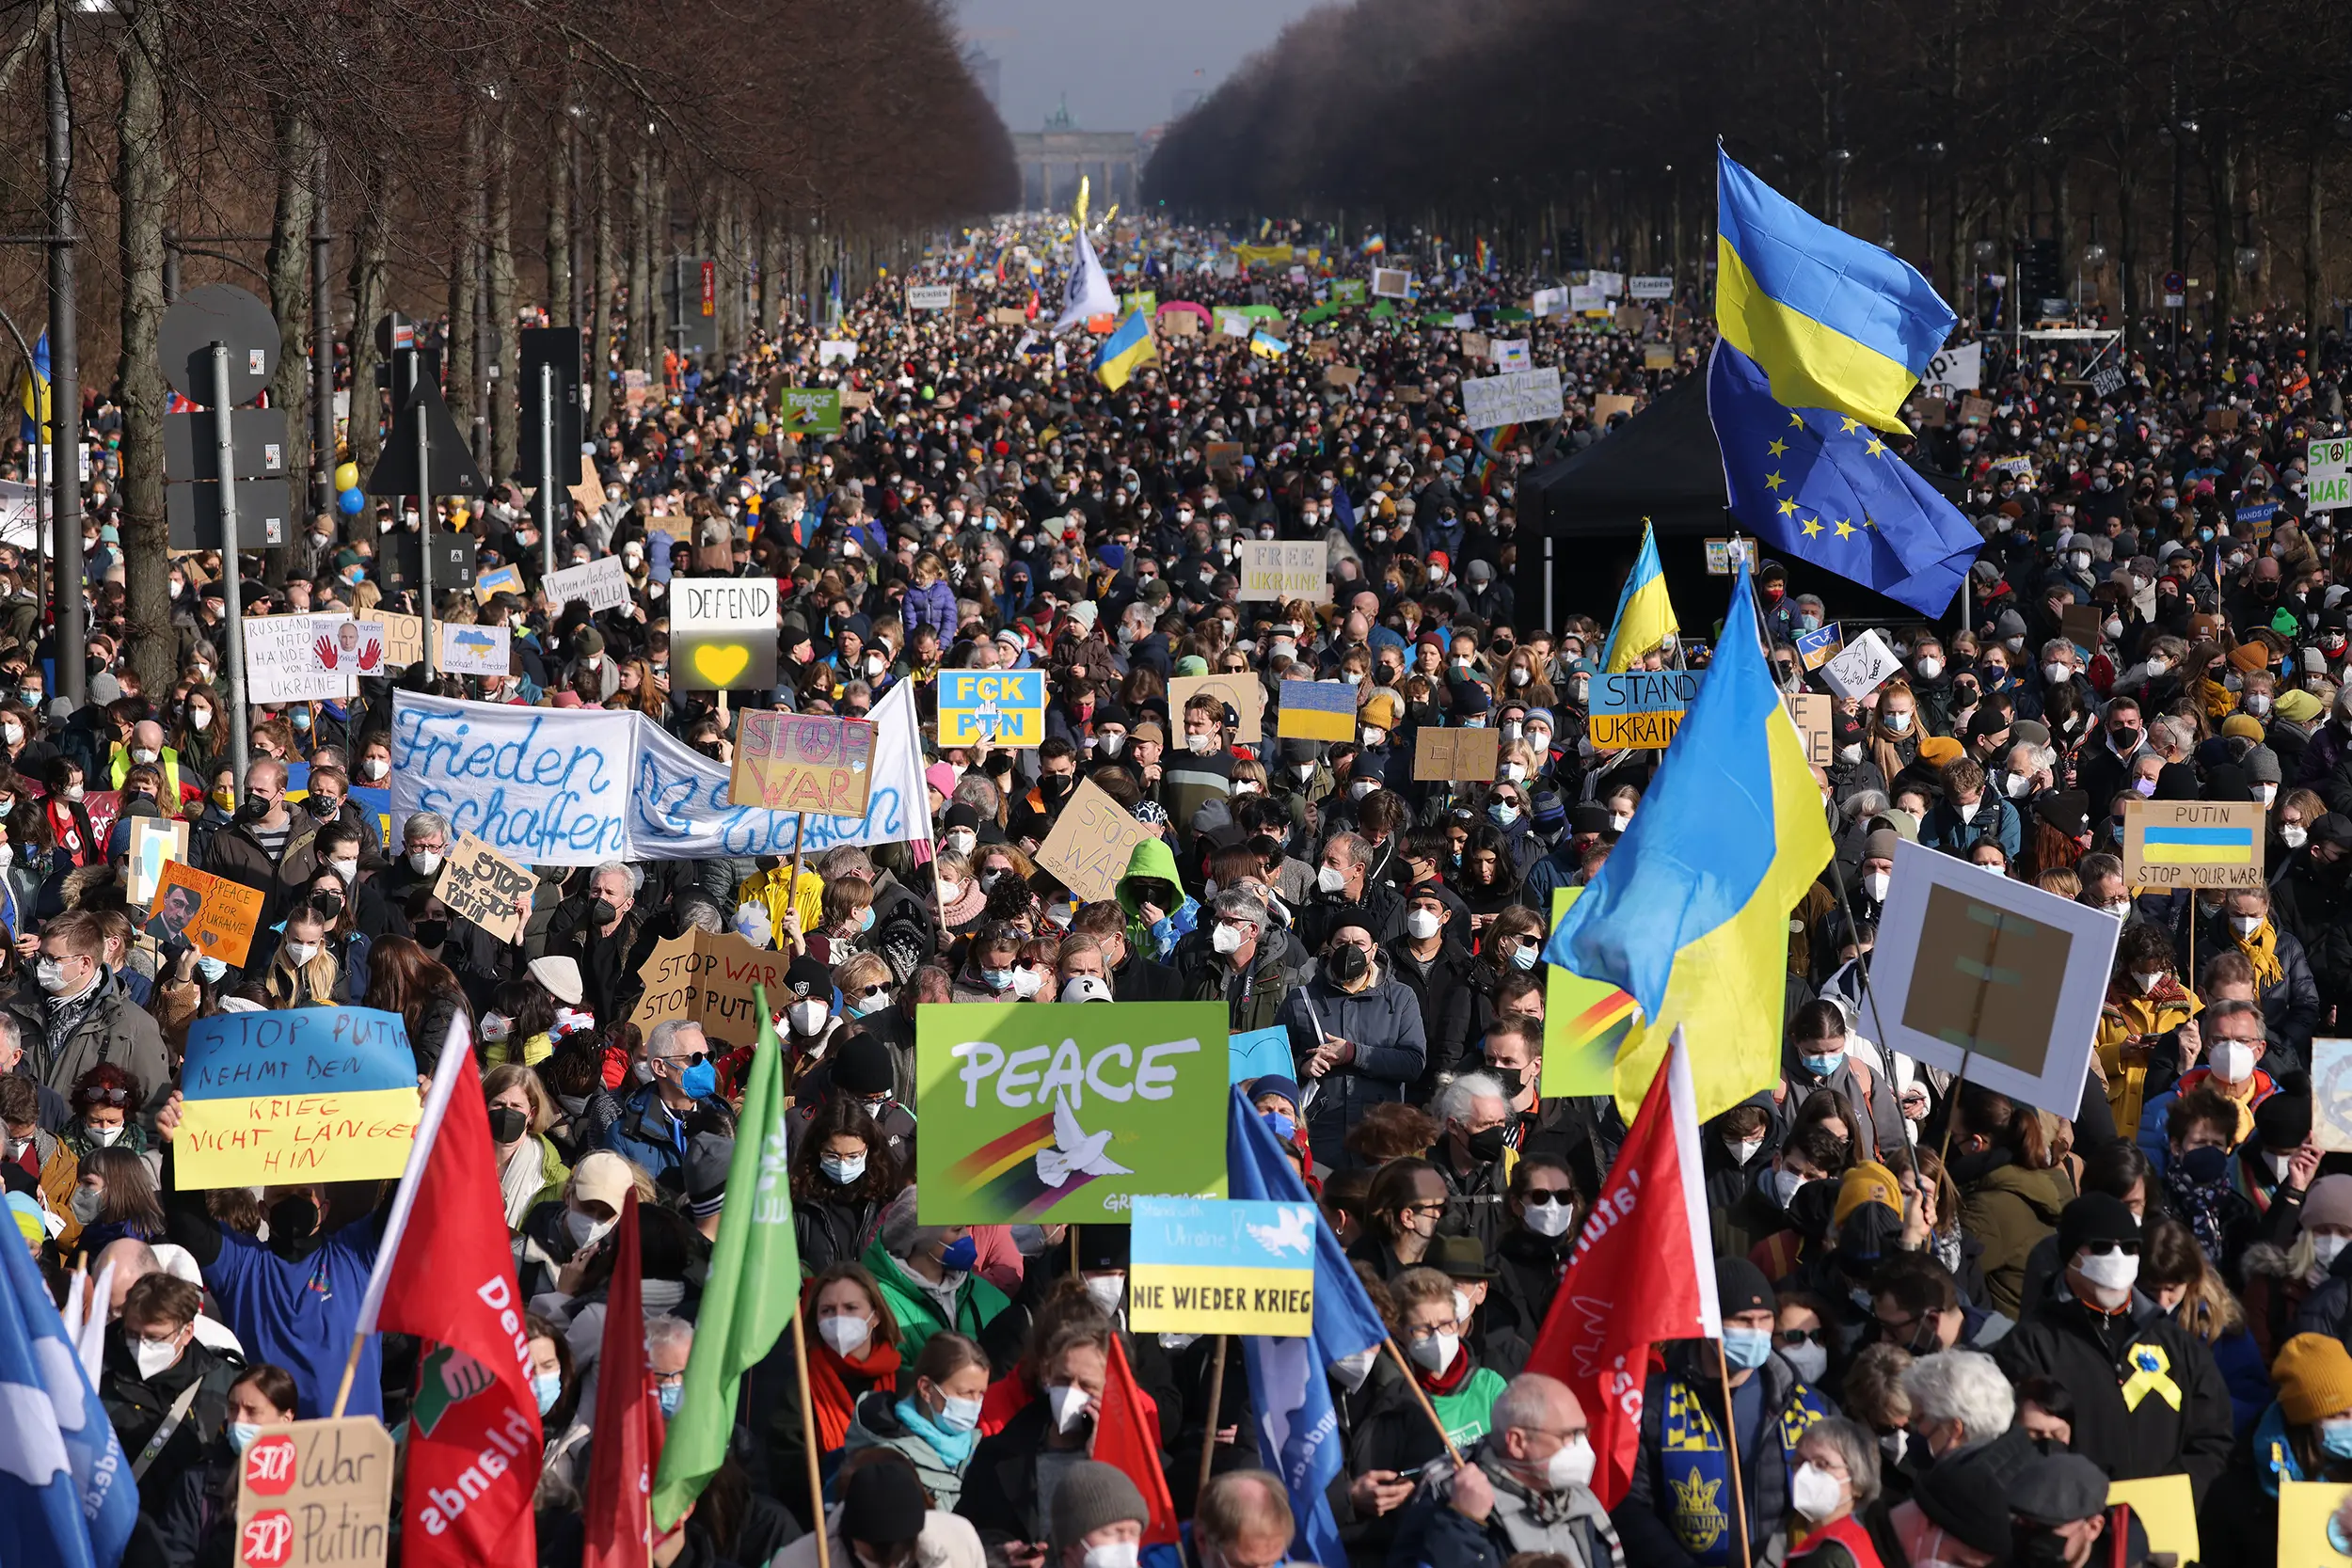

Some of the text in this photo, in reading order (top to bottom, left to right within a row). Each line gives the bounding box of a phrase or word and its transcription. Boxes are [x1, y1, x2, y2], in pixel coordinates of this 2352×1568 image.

[787, 393, 834, 407] PEACE
[2310, 478, 2349, 504] WAR
[2236, 510, 2263, 521] HANDS
[1254, 546, 1315, 566] FREE
[547, 577, 578, 596] Путин
[1248, 570, 1321, 592] UKRAINE
[688, 587, 771, 620] DEFEND
[248, 617, 310, 638] RUSSLAND
[277, 632, 311, 648] NATO
[255, 647, 306, 666] HÄNDE
[282, 664, 302, 673] VON
[270, 674, 336, 697] UKRAINE
[957, 676, 1025, 701] FCK
[1604, 674, 1697, 706] STAND
[958, 713, 1024, 736] PTN
[1640, 705, 1677, 718] WITH
[744, 712, 872, 768] STOP
[1419, 730, 1498, 753] STOP
[1595, 715, 1683, 743] UKRAIN
[393, 708, 611, 794] Frieden
[1422, 753, 1492, 779] WAR
[745, 757, 854, 811] WAR
[1077, 799, 1137, 851] STOP
[2175, 806, 2231, 824] PUTIN
[1046, 856, 1069, 875] STOP
[1064, 830, 1127, 896] WAR
[2137, 865, 2264, 885] STOP YOUR WAR!
[472, 851, 533, 902] STOP
[216, 881, 252, 905] PEACE
[445, 881, 488, 924] PUTIN
[480, 887, 516, 924] STOP
[218, 903, 237, 917] FOR
[206, 911, 247, 936] UKRAINE
[657, 952, 777, 990] STOP WAR
[643, 985, 771, 1023] STOP PUT
[206, 1013, 411, 1054] STOP PUTIN
[199, 1054, 366, 1090] NEHMT DEN
[951, 1037, 1201, 1110] PEACE
[249, 1097, 342, 1121] KRIEG
[185, 1129, 273, 1155] NICHT
[263, 1144, 329, 1175] HIN
[1165, 1223, 1227, 1248] Ukraine
[1133, 1285, 1311, 1313] NIE WIEDER KRIEG
[246, 1429, 375, 1488] STOP War
[243, 1501, 384, 1564] STOP Putin
